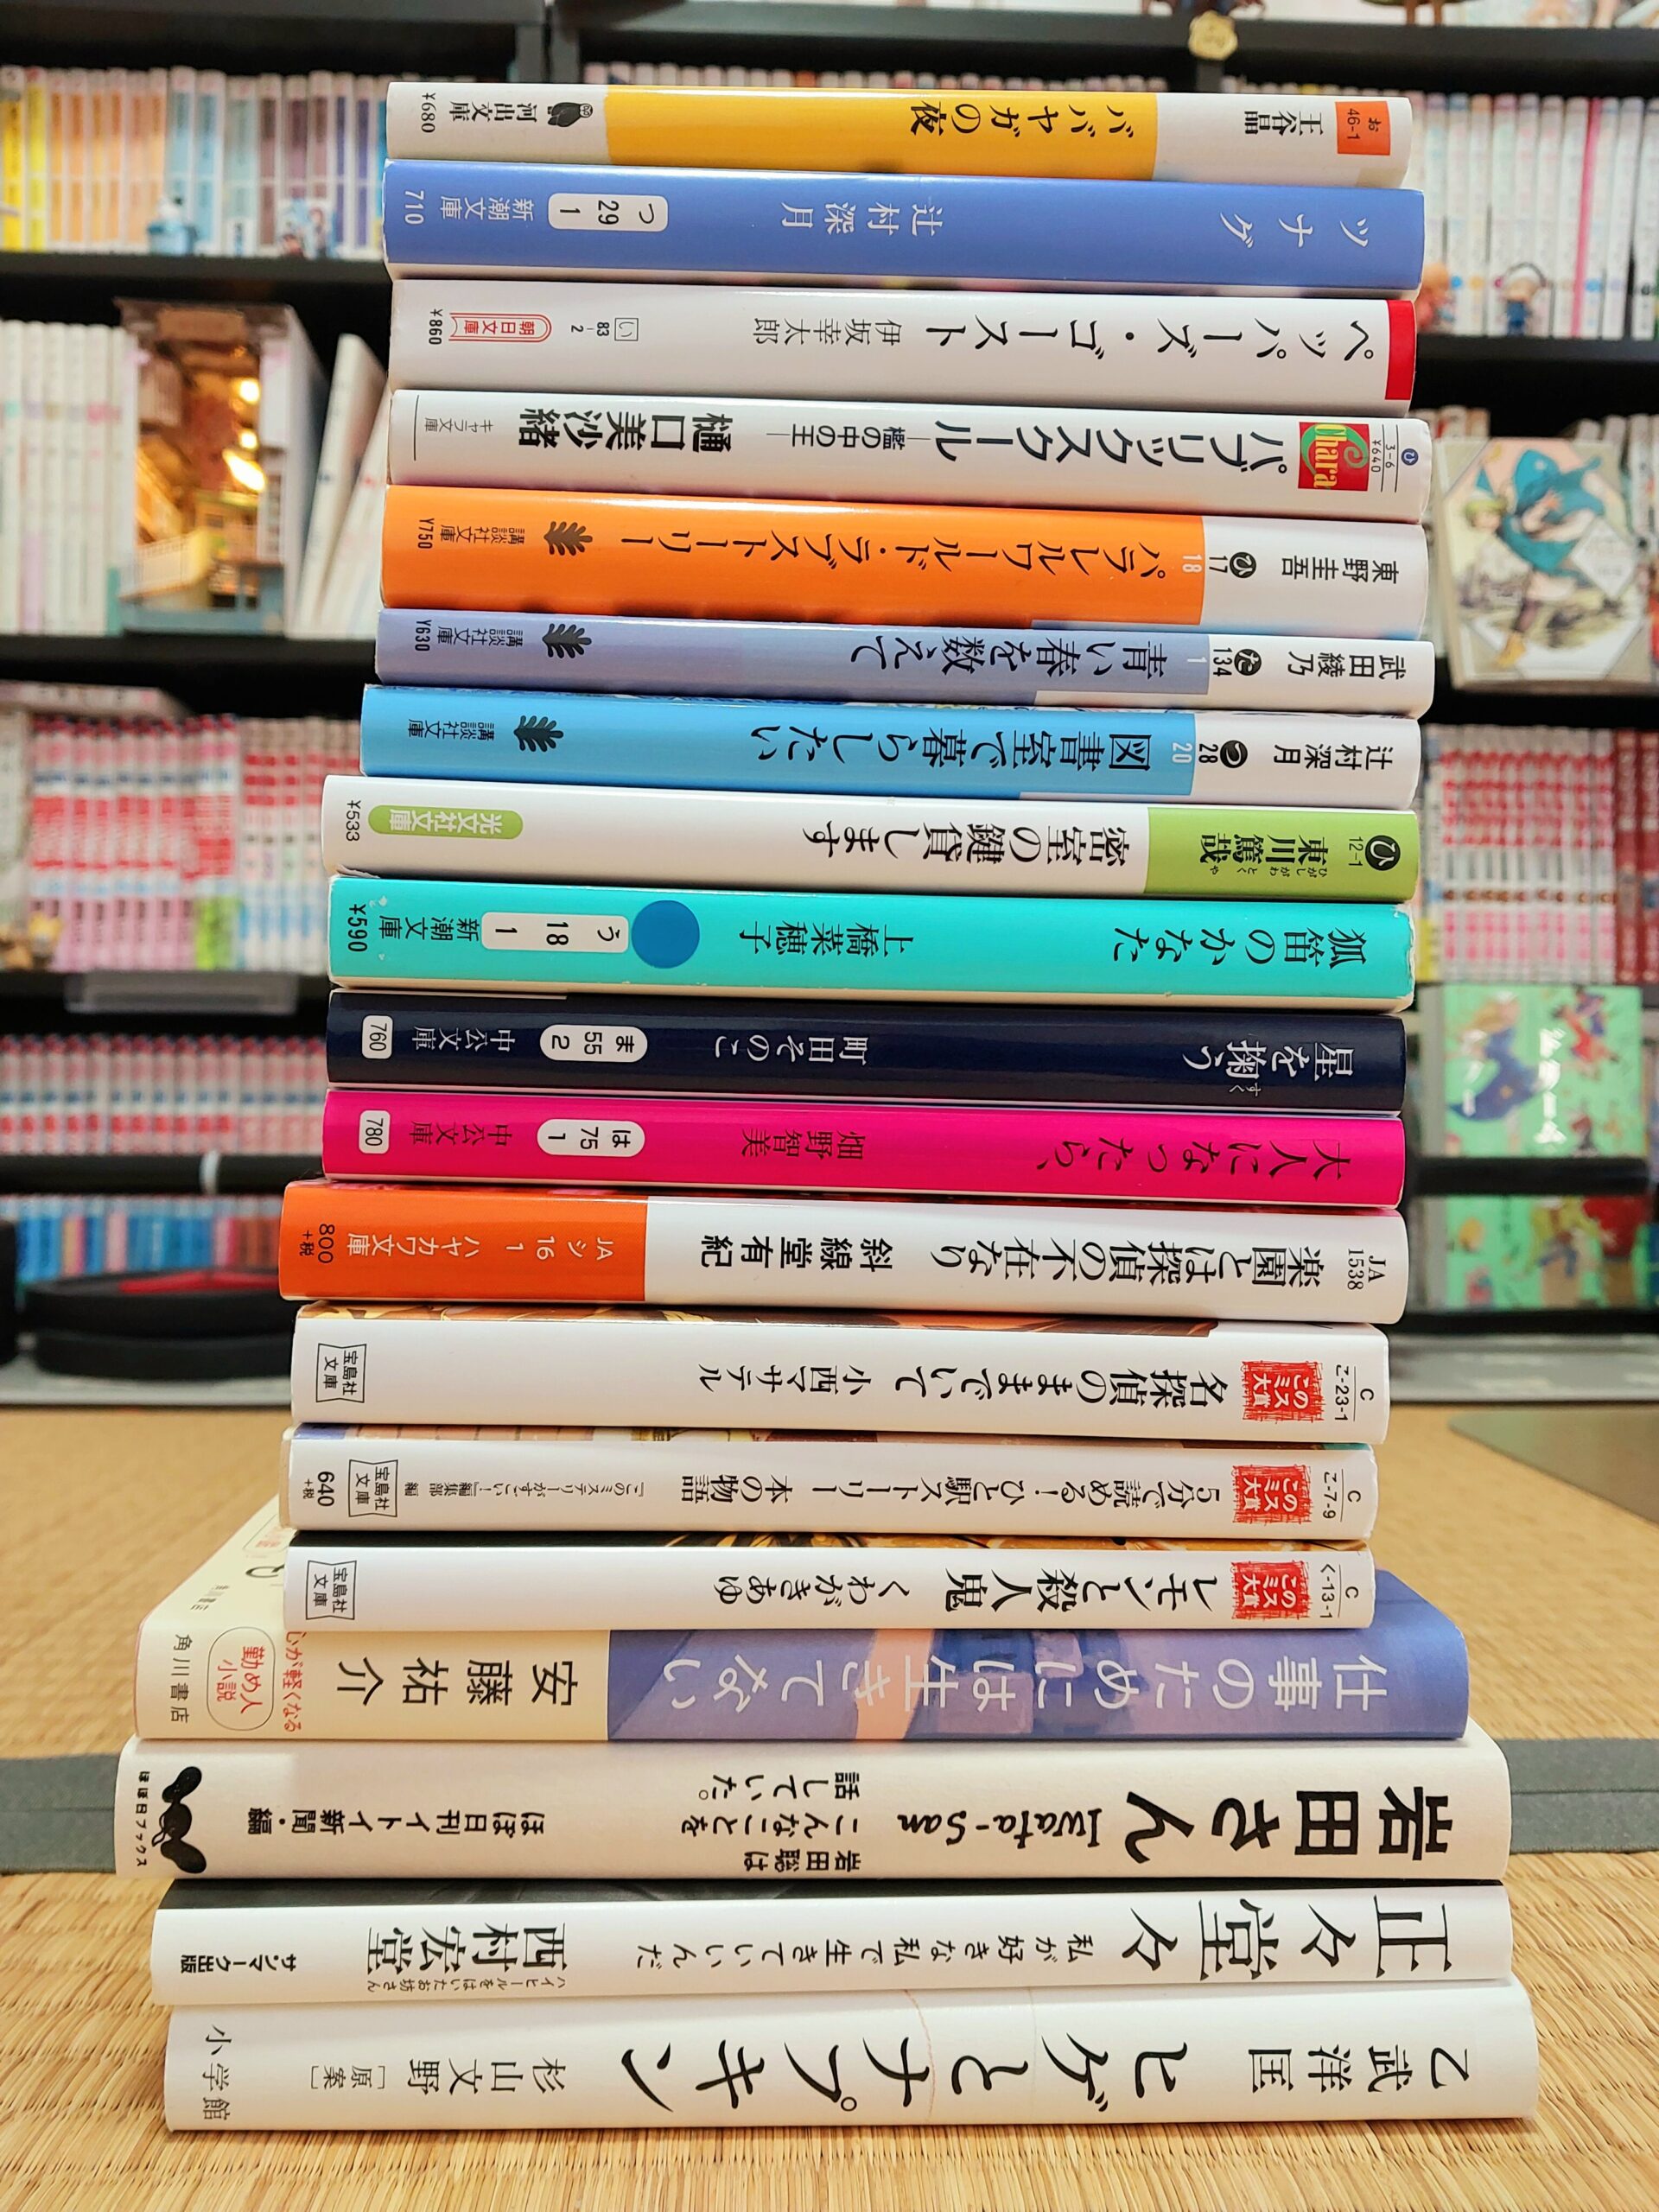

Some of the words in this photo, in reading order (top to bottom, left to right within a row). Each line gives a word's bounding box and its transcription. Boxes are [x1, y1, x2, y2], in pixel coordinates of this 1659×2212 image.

[449, 101, 537, 122] 河出文庫
[910, 101, 1134, 139] ババヤガの夜
[1244, 111, 1323, 136] 王谷晶
[1346, 108, 1360, 140] 46-1
[1367, 118, 1381, 131] お
[404, 190, 424, 225] 710
[439, 196, 534, 222] 新潮文庫
[598, 200, 618, 226] 29
[639, 203, 656, 225] つ
[781, 200, 944, 237] 辻村深月
[1219, 213, 1370, 249] ツナグ
[463, 319, 536, 336] 朝日文庫
[619, 321, 634, 337] い
[753, 317, 903, 347] 伊坂幸太郎
[926, 314, 1375, 360] ペッパーズ・ゴースト
[424, 416, 494, 434] キャラ文庫
[518, 408, 734, 454] 樋口美沙緒
[933, 420, 1287, 474] パブリックスクール
[1384, 444, 1396, 468] 3-6
[440, 524, 525, 546] 講談社文庫
[1182, 554, 1202, 573] 18
[1209, 555, 1229, 574] 17
[1234, 555, 1253, 575] ひ
[1281, 556, 1398, 584] 東野圭吾
[436, 626, 523, 648] 講談社文庫
[849, 633, 1168, 680] 青い春を数えて
[1212, 646, 1232, 677] 134
[1237, 652, 1259, 672] た
[1287, 652, 1407, 681] 武田綾乃
[406, 719, 494, 742] 講談社文庫
[751, 724, 1152, 771] 図書室で暮らしたい
[1172, 742, 1192, 764] 20
[1198, 743, 1217, 764] 28
[1226, 745, 1242, 765] つ
[1274, 744, 1393, 771] 辻村深月
[389, 808, 502, 836] 光文社文庫
[803, 819, 1130, 867] 密室の鍵貸します
[1199, 833, 1329, 865] 東川篤哉
[1349, 836, 1363, 868] 12-1
[1370, 840, 1395, 866] ひ
[1236, 867, 1257, 875] とく
[1269, 866, 1290, 877] がわ
[1296, 867, 1327, 878] ひがし
[378, 915, 480, 942] 新潮文庫
[546, 921, 569, 946] 18
[596, 925, 620, 942] う
[739, 920, 914, 957] 上橋菜穂子
[1113, 928, 1367, 969] 狐笛のかなた
[367, 1022, 387, 1052] 760
[412, 1027, 515, 1052] 中公文庫
[551, 1033, 570, 1050] 2
[584, 1031, 604, 1055] 55
[615, 1035, 635, 1053] ま
[714, 1034, 868, 1066] 町田そのこ
[1182, 1040, 1355, 1082] 星を掬う
[1228, 1084, 1261, 1097] すく
[365, 1117, 385, 1147] 780
[410, 1122, 512, 1147] 中公文庫
[579, 1126, 601, 1150] 75
[611, 1129, 632, 1149] は
[741, 1128, 866, 1161] 畑野智美
[316, 1223, 335, 1264] 800
[346, 1232, 481, 1257] ハヤカワ文庫
[536, 1235, 556, 1261] 16
[568, 1240, 588, 1259] シ
[595, 1236, 615, 1261] JA
[700, 1234, 894, 1272] 斜線堂有紀
[930, 1236, 1324, 1288] 楽園とは探偵の不在なり
[1347, 1248, 1364, 1290] 1538
[1368, 1255, 1386, 1282] JA
[321, 1355, 339, 1389] 文庫
[341, 1350, 359, 1395] 宝島社
[697, 1363, 872, 1395] 小西マサテル
[893, 1364, 1229, 1408] 名探偵のままでいて
[1252, 1373, 1270, 1408] 大賞
[1274, 1374, 1289, 1408] ミス
[1293, 1374, 1310, 1408] この
[1334, 1363, 1351, 1421] こ-23-1
[316, 1471, 334, 1508] 640
[354, 1472, 372, 1505] 文庫
[373, 1466, 390, 1510] 宝島社
[404, 1481, 420, 1497] 編
[681, 1474, 793, 1504] 本の物語
[1243, 1477, 1261, 1511] 大賞
[1263, 1477, 1280, 1511] ミス
[1283, 1477, 1300, 1511] この
[1321, 1471, 1338, 1520] こ-7-9
[312, 1574, 328, 1607] 文庫
[332, 1567, 348, 1614] 宝島社
[714, 1575, 911, 1607] くわがきあゆ
[944, 1568, 1218, 1614] レモンと殺人鬼
[1242, 1574, 1259, 1609] 大賞
[1262, 1574, 1278, 1609] ミス
[1281, 1574, 1299, 1609] この
[1319, 1562, 1336, 1619] く-13-1
[169, 1633, 192, 1724] 角川書店
[216, 1659, 237, 1702] 小説
[241, 1645, 265, 1714] 勤め人
[335, 1656, 577, 1707] 安藤祐介
[663, 1654, 1388, 1714] 仕事のためには生きてない
[135, 1770, 149, 1867] ほぼ日ブックス
[681, 1811, 857, 1840] こんなことを
[1123, 1785, 1453, 1863] 岩田さん
[744, 1847, 860, 1873] 岩田聡は
[365, 1922, 568, 1976] 西村宏堂
[634, 1933, 1094, 1971] 私が好きな私で生きていいんだ
[1120, 1894, 1453, 1981] 正々堂々
[180, 1954, 296, 1974] サンマーク出版
[365, 1976, 566, 1993] ハイヒールをはいたお坊さん
[200, 2024, 232, 2122] 小学館
[407, 2056, 567, 2094] 杉山文野
[620, 2033, 1188, 2113] ヒゲとナプキン
[1247, 2044, 1469, 2094] 乙武洋匡
